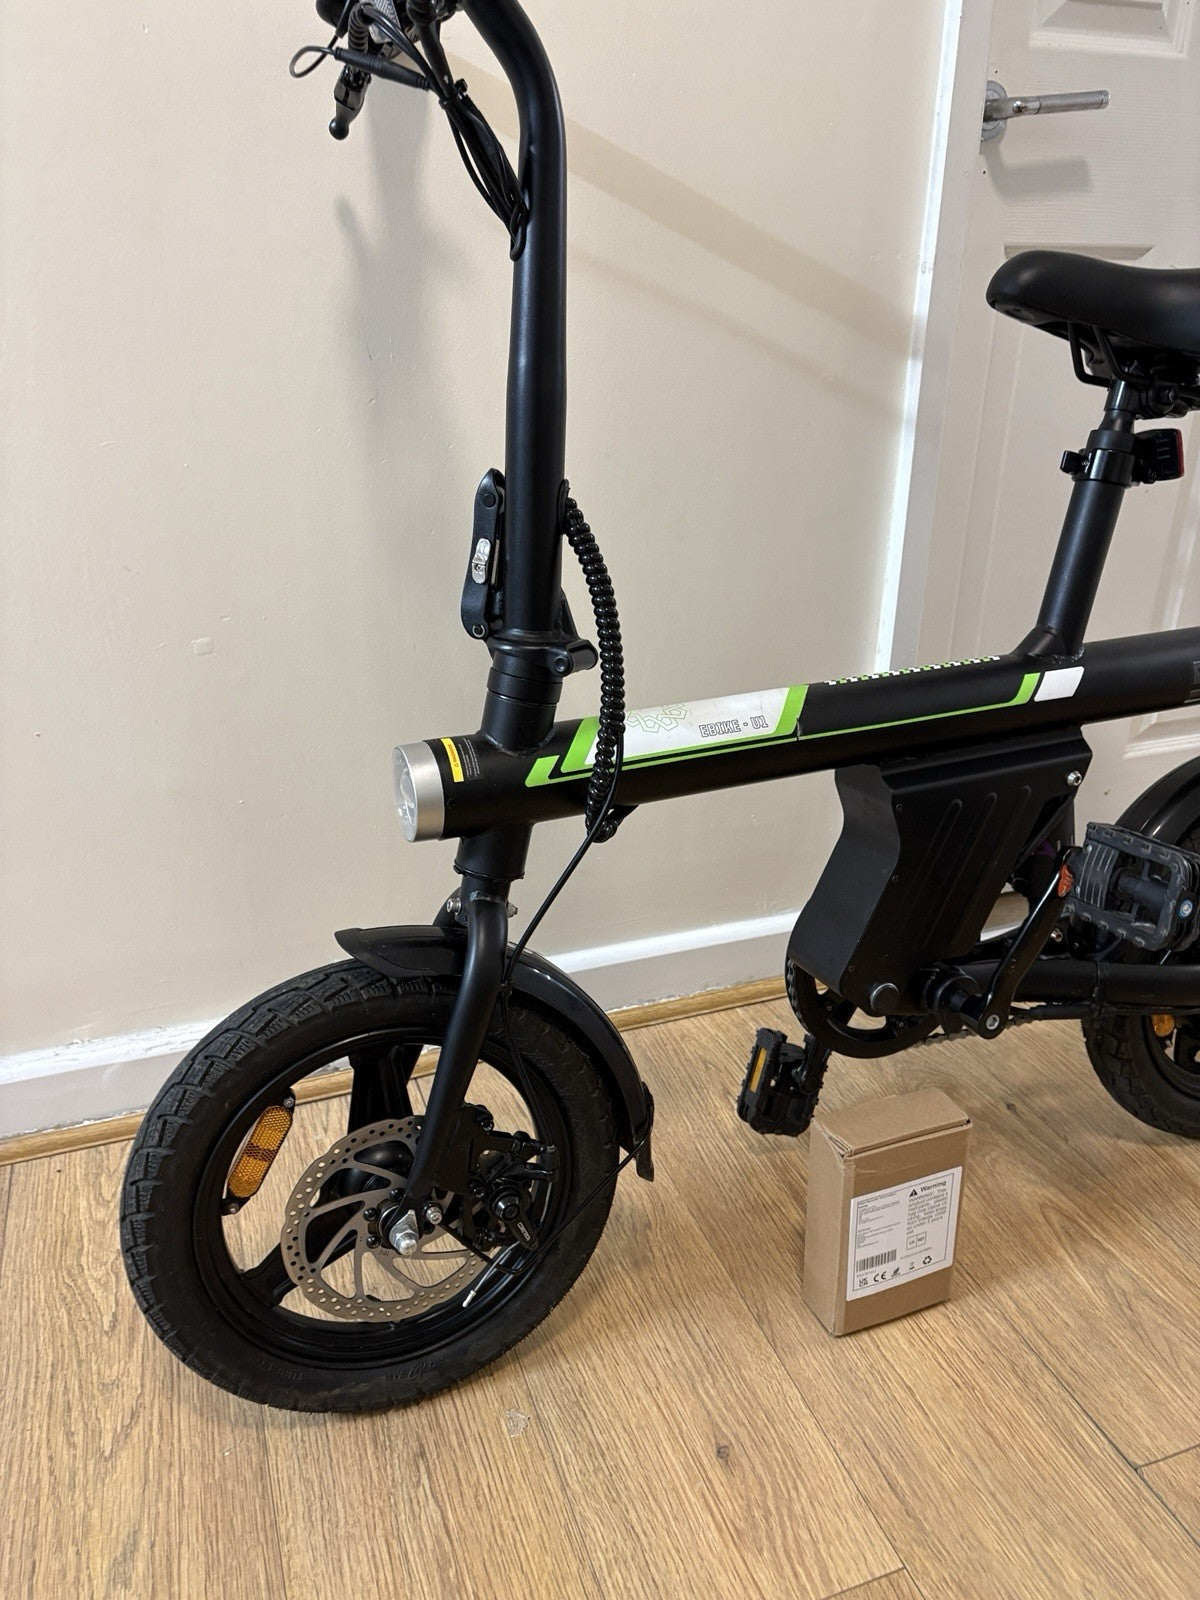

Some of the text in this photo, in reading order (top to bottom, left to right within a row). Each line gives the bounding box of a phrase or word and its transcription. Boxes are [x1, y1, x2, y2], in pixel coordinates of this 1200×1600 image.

[699, 719, 741, 738] EBIKE
[750, 715, 769, 729] U1
[921, 1181, 946, 1192] Warning
